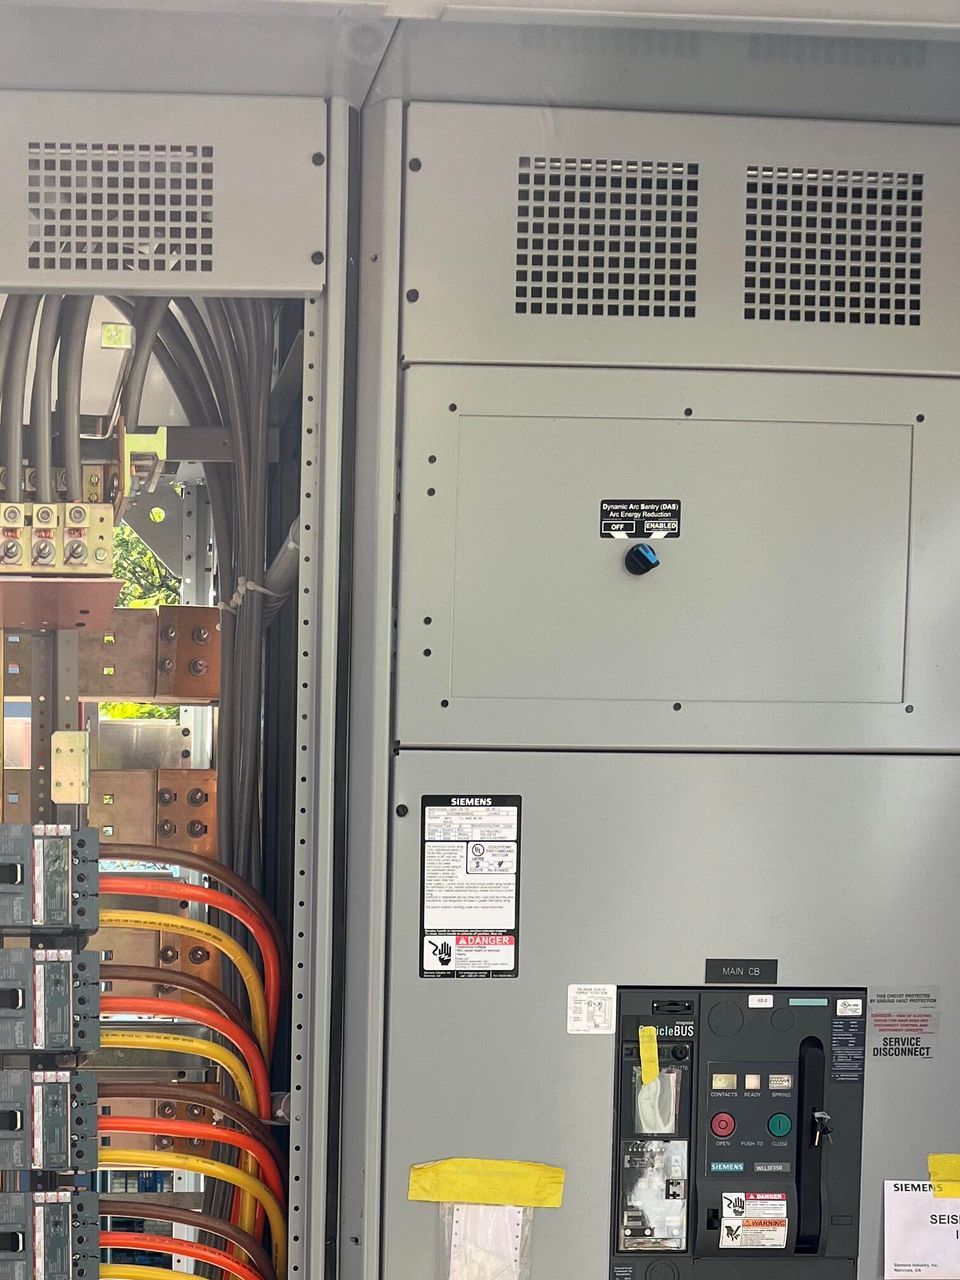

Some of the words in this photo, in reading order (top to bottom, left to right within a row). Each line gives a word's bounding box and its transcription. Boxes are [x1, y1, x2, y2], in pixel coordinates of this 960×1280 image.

[640, 503, 659, 511] Sentry
[660, 503, 679, 511] (DAS)
[451, 797, 492, 806] SIEMENS
[467, 936, 510, 944] DANGER
[722, 967, 744, 976] MAIN
[748, 967, 760, 976] CB
[882, 1037, 921, 1046] SERVICE
[872, 1047, 931, 1056] DISCONNECT
[711, 1163, 744, 1171] SIEMENS
[893, 1183, 943, 1192] SIEMENS
[929, 1214, 960, 1225] SEIS
